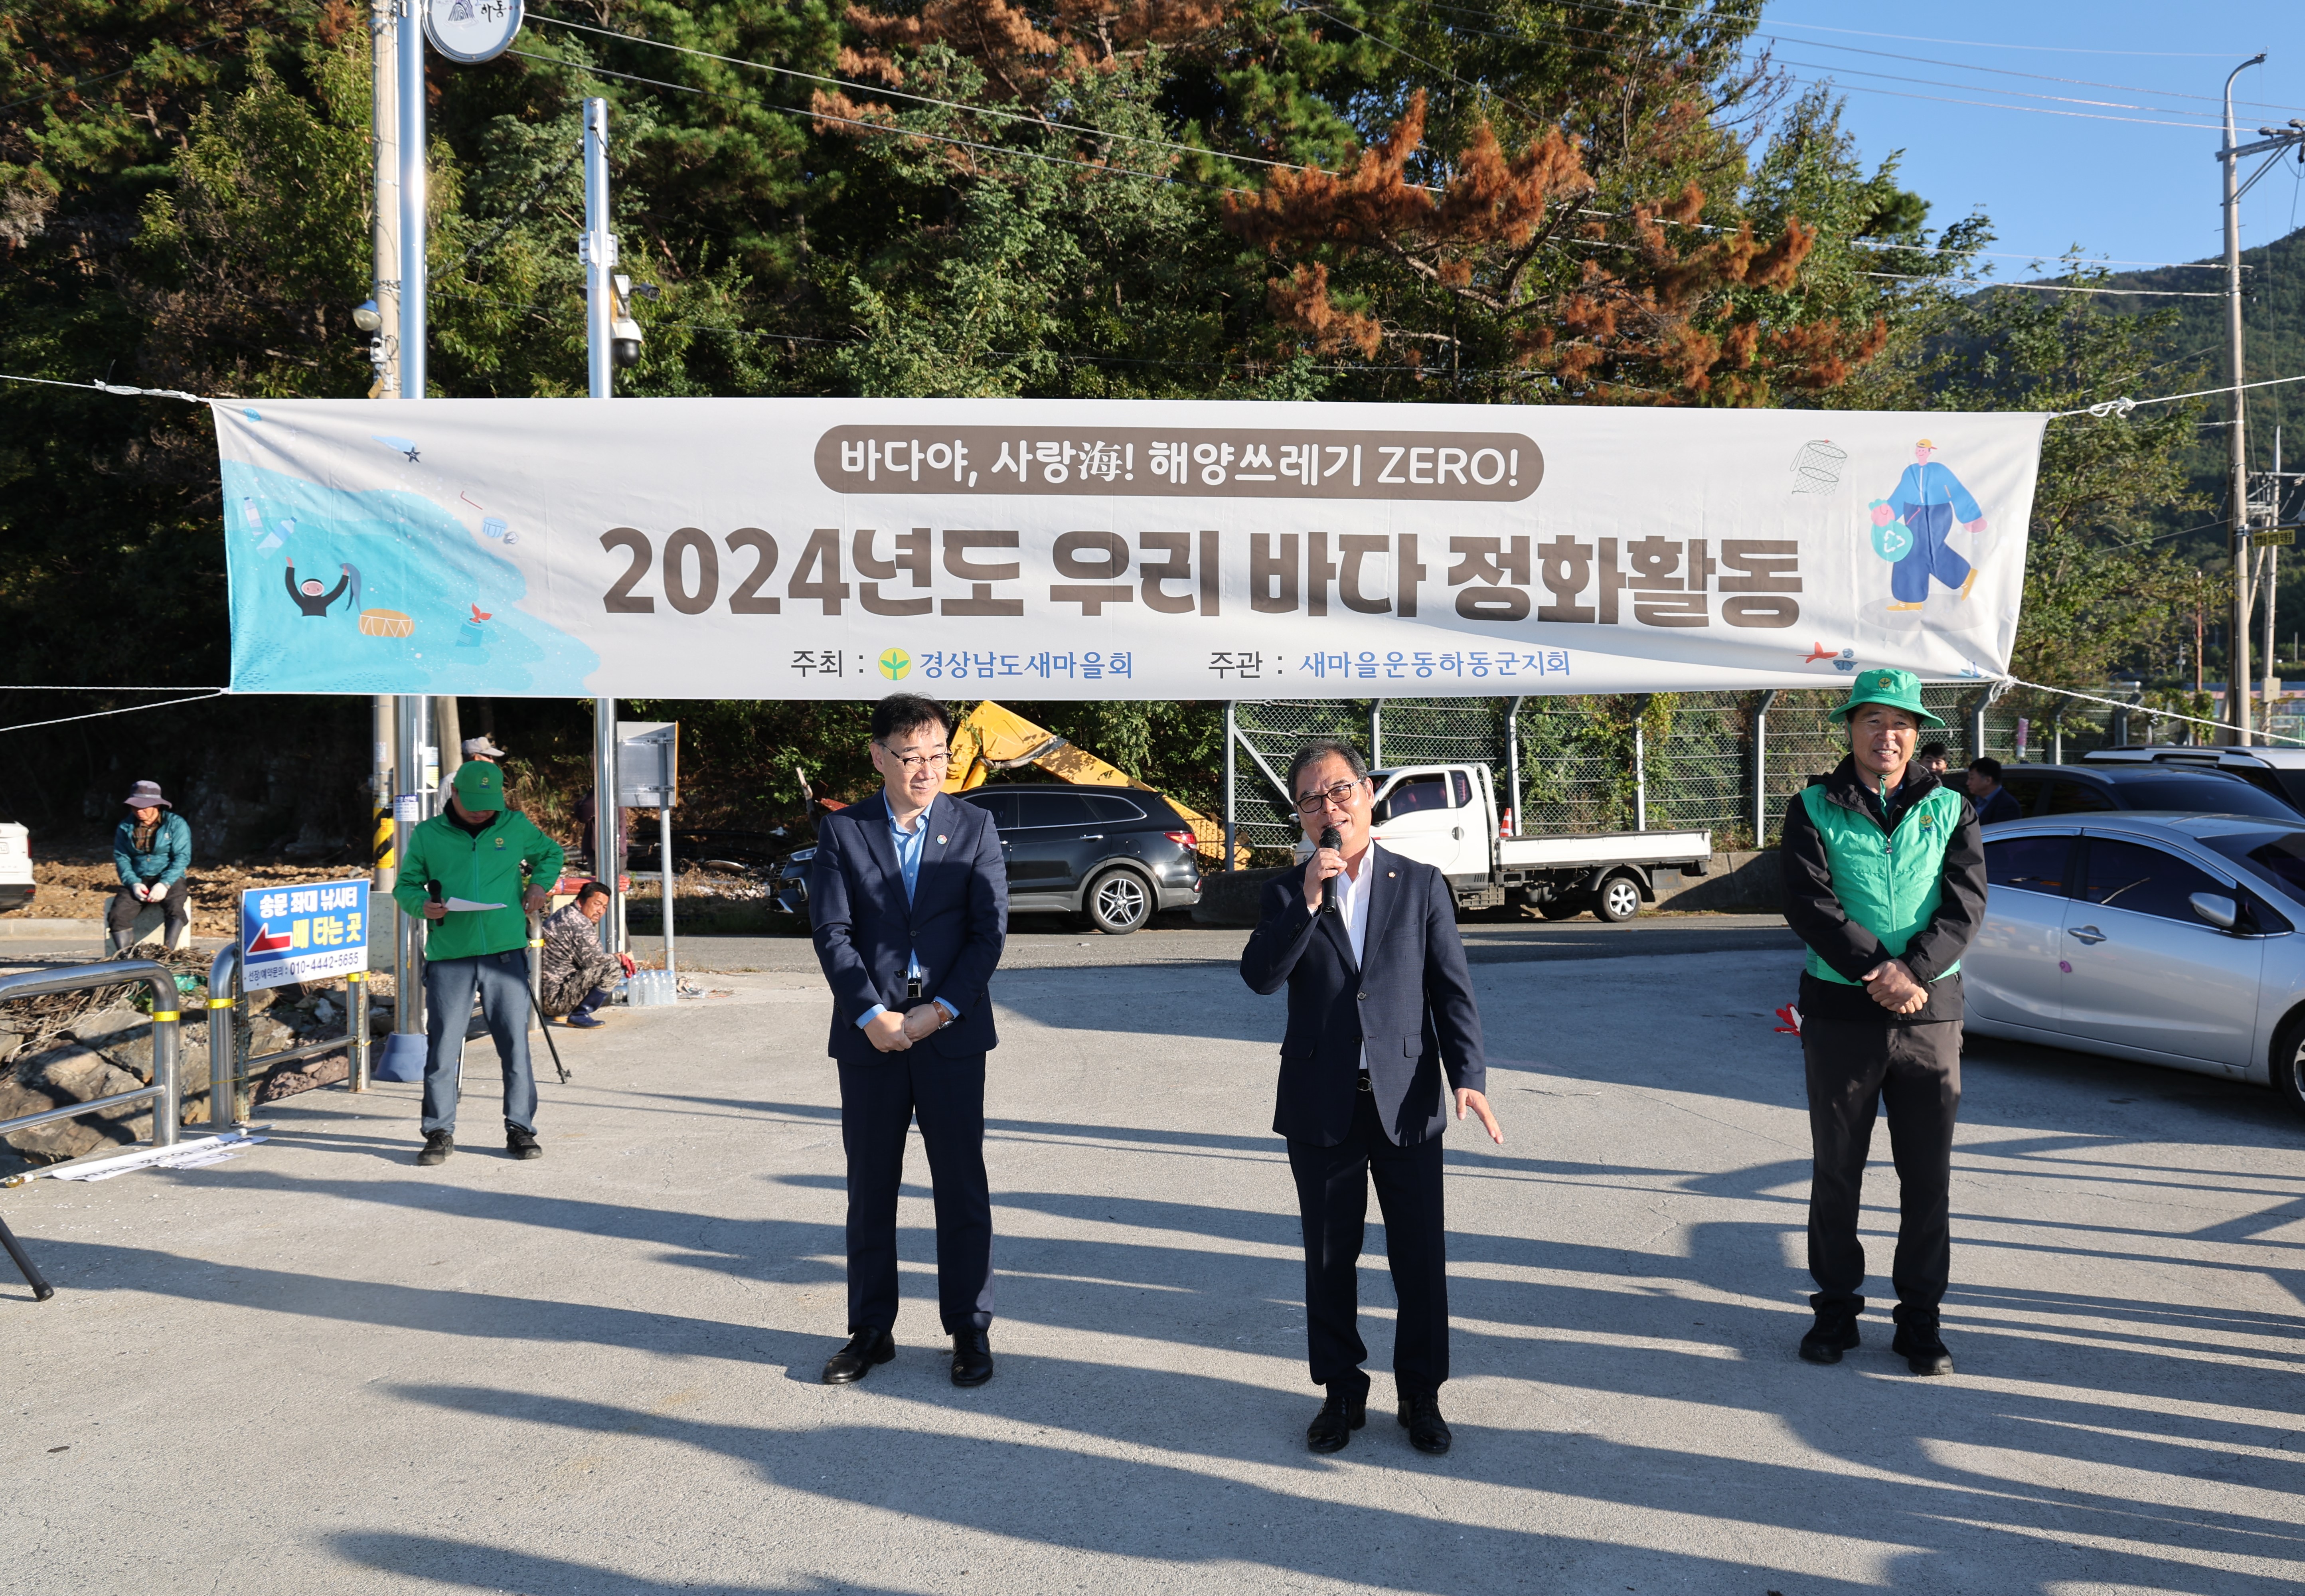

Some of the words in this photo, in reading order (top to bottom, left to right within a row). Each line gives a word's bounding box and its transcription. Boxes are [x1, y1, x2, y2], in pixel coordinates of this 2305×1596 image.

[481, 0, 506, 23] 하동
[841, 439, 978, 488] 바다야,
[991, 440, 1134, 484] 사랑海!
[1148, 441, 1361, 487] 해양쓰레기
[1377, 446, 1518, 487] ZERO!
[600, 527, 1024, 617] 2024년도
[1049, 527, 1220, 617] 우리
[1250, 531, 1427, 618] 바다
[1447, 535, 1803, 628] 정화활동
[790, 650, 842, 678] 주최
[919, 651, 1132, 679] 경상남도새마을회
[1208, 651, 1263, 679] 주관
[1299, 651, 1570, 678] 새마을운동하동군지회
[260, 894, 288, 918] 송문
[290, 890, 318, 914] 좌대
[320, 886, 358, 911] 낚시터
[293, 918, 310, 949] 배
[313, 916, 344, 946] 타는
[346, 912, 361, 943] 곳
[290, 952, 358, 976] 010-4442-5655
